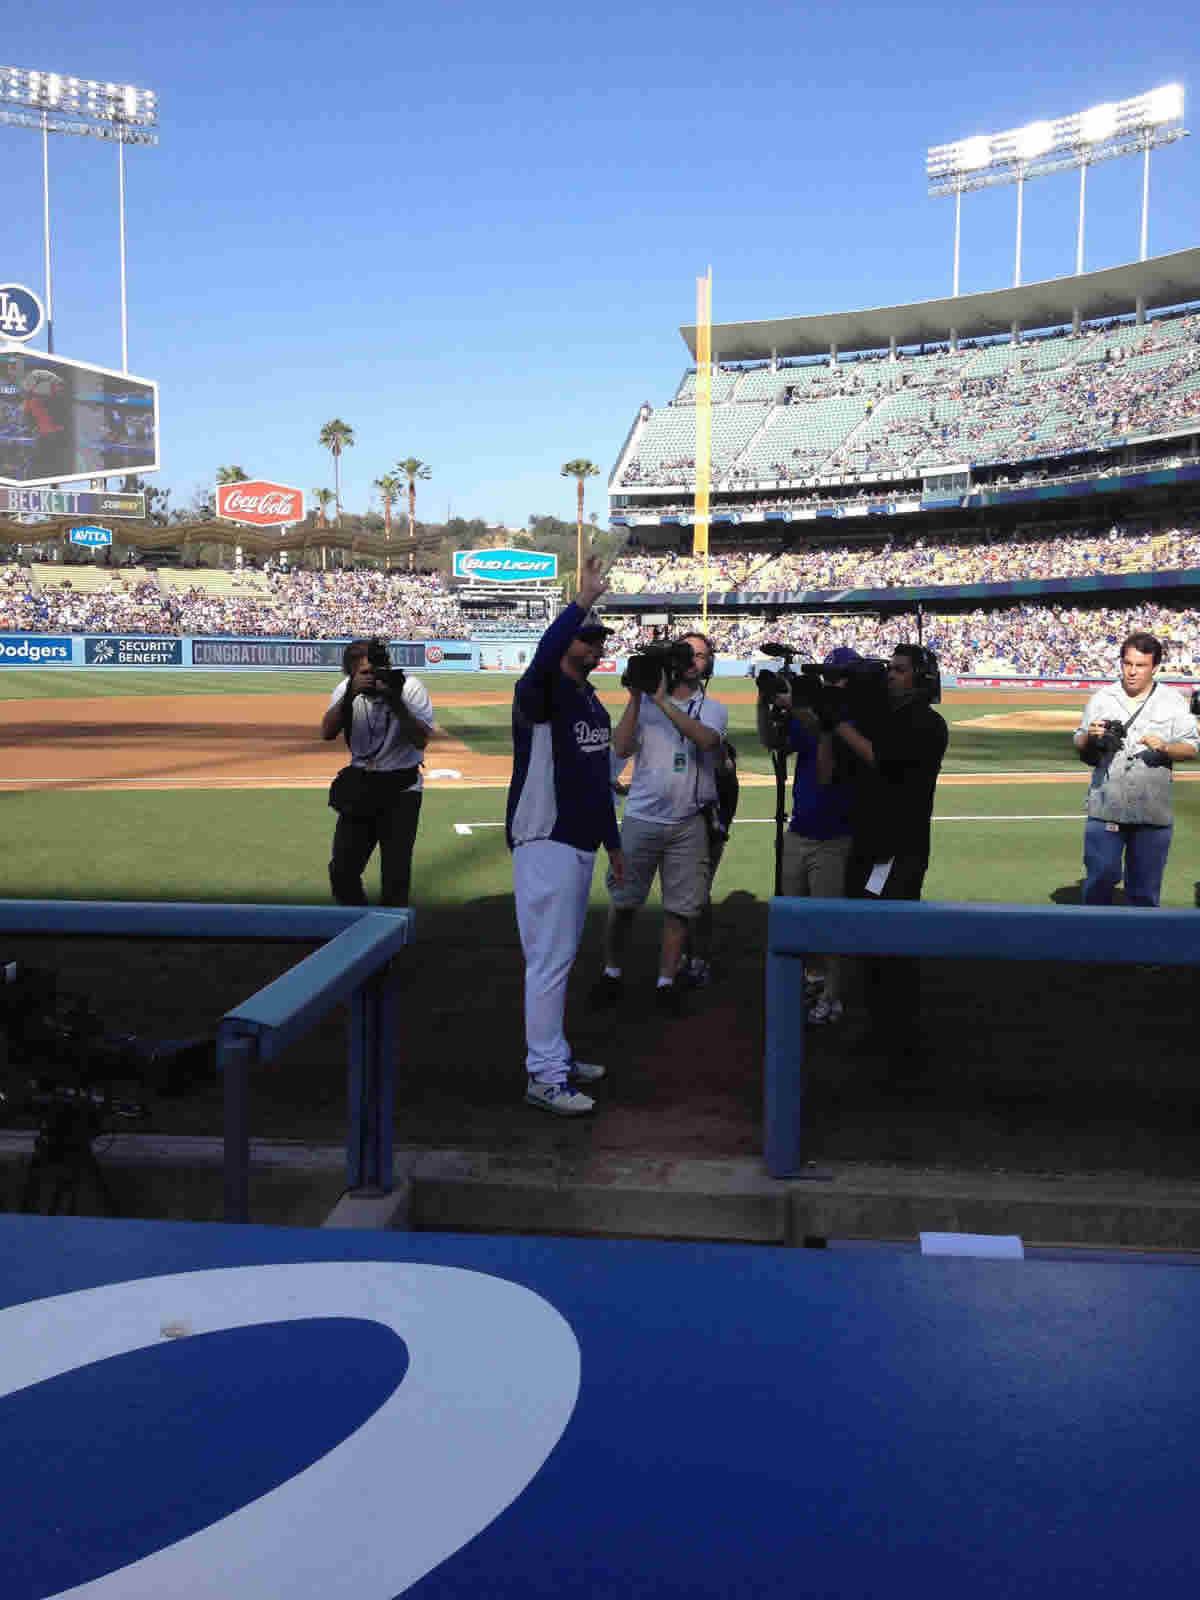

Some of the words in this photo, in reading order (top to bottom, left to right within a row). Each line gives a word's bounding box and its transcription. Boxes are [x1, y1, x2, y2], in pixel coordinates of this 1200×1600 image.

[8, 490, 81, 513] BECKETT
[119, 639, 177, 651] SECURITY
[193, 643, 321, 664] CONGRATULATIONS
